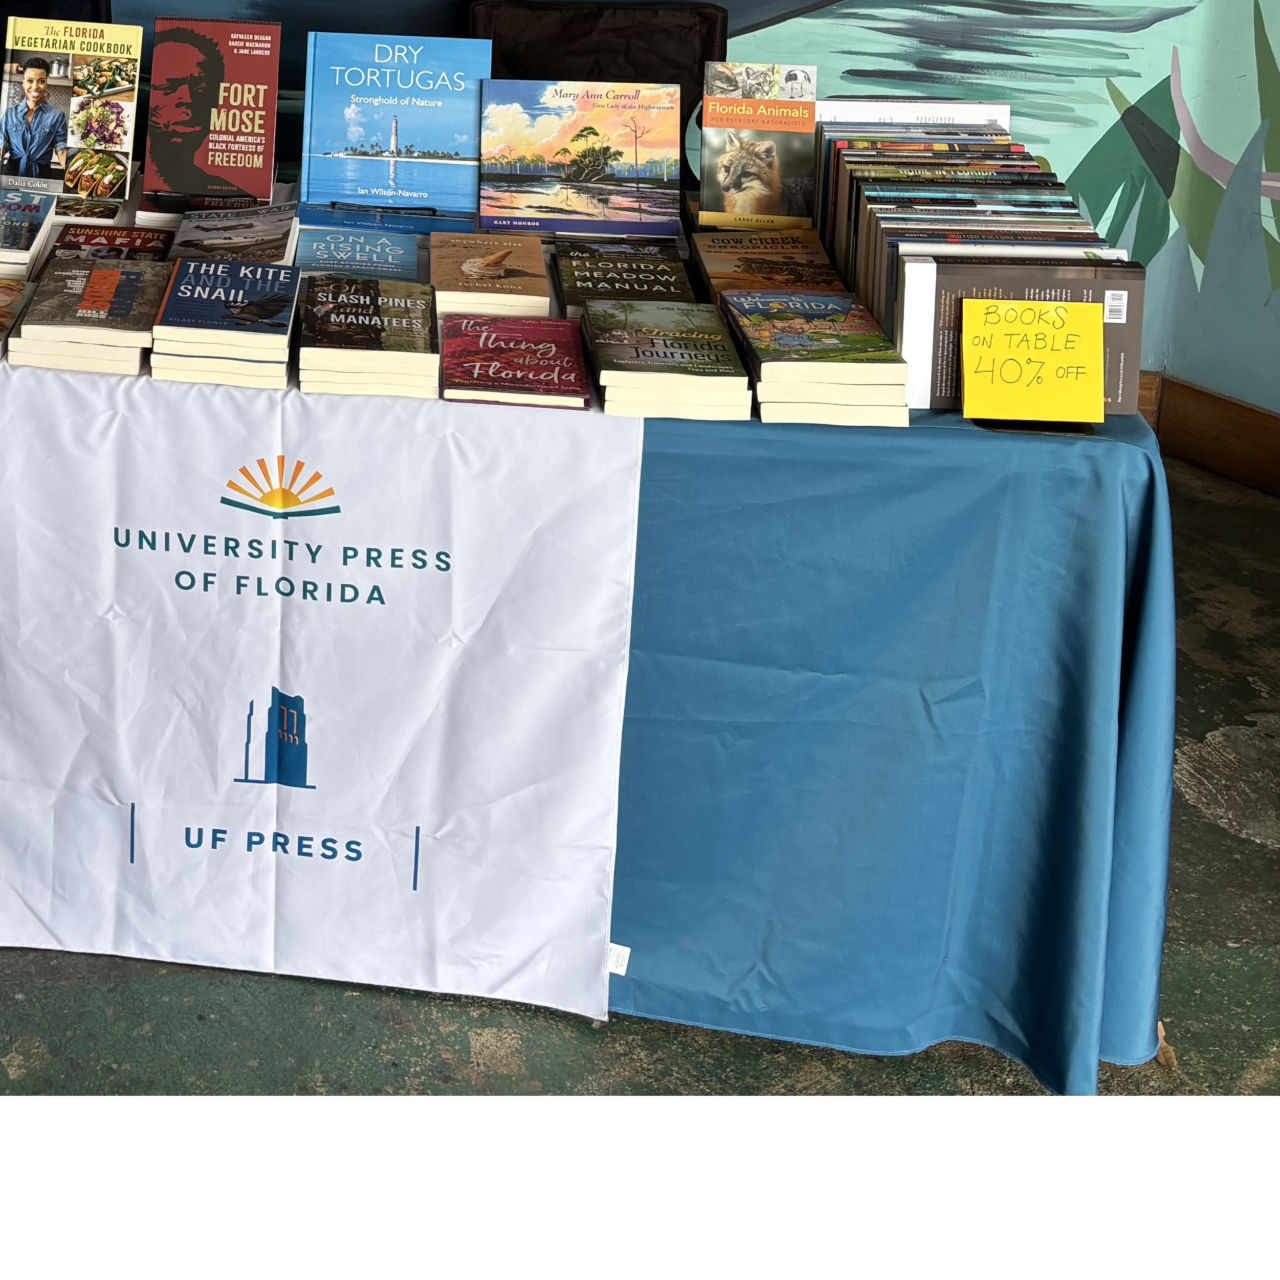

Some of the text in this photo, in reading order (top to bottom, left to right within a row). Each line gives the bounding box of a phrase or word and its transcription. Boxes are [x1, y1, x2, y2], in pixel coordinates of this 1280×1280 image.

[44, 25, 106, 40] The FLORIDA
[230, 33, 253, 41] KATHLEEN
[14, 36, 133, 56] VEGETARIAN COOKBOOK
[228, 40, 244, 48] DARCIE
[374, 43, 424, 65] DRY
[330, 66, 466, 92] TORTUGAS
[218, 82, 268, 108] FORT
[350, 94, 443, 107] Stronghold of Nature
[552, 88, 641, 100] Mary Ann Carroll
[606, 103, 620, 111] Lady
[708, 102, 810, 118] Florida Animals
[209, 107, 266, 134] MOSE
[726, 117, 759, 125] EVERYDAY
[761, 119, 807, 127] NATURALISTS
[209, 133, 266, 144] COLONIAL AMERICA'S
[208, 142, 265, 152] BLACK FORTRESS OF
[207, 151, 264, 168] FREEDOM
[7, 178, 48, 189] Dalia Colón
[357, 186, 429, 198] Ian Wilson-Navarro
[204, 200, 261, 208] FREEDOM
[190, 211, 238, 220] STATE
[257, 204, 291, 215] WAR
[68, 227, 168, 240] SUNSHINE STATE
[325, 234, 392, 245] ON A
[981, 234, 1015, 242] PICTURE
[63, 234, 165, 248] MAFIA
[449, 238, 499, 246] anywhere
[711, 236, 804, 246] COW CREEK
[312, 242, 405, 255] RISING
[315, 250, 401, 263] SWELL
[938, 257, 991, 265] RETURN
[186, 262, 292, 282] THE KITE
[571, 260, 671, 271] FLORIDA
[574, 271, 677, 282] MEADOW
[181, 273, 287, 294] AND THE
[329, 283, 361, 294] Of
[576, 281, 682, 293] MANUAL
[178, 285, 249, 303] SNAIL
[732, 296, 790, 304] Welcome
[317, 293, 426, 309] SLASH PINES
[743, 301, 843, 312] FLORIDA
[340, 306, 375, 314] and
[330, 313, 422, 328] MANATEES
[983, 304, 1069, 330] BOOKS
[461, 319, 494, 332] The
[641, 326, 726, 342] Tracing
[479, 331, 558, 358] Thing
[649, 338, 729, 352] Florida
[972, 332, 1081, 352] ON TABLE
[514, 356, 573, 367] about
[629, 346, 733, 364] Journeys
[463, 361, 577, 384] Florida
[974, 355, 1045, 387] 40%
[1055, 366, 1087, 381] OFF
[114, 527, 452, 572] UNIVERSITY PRESS
[174, 570, 386, 605] OF FLORIDA
[185, 826, 363, 862] UF PRESS
